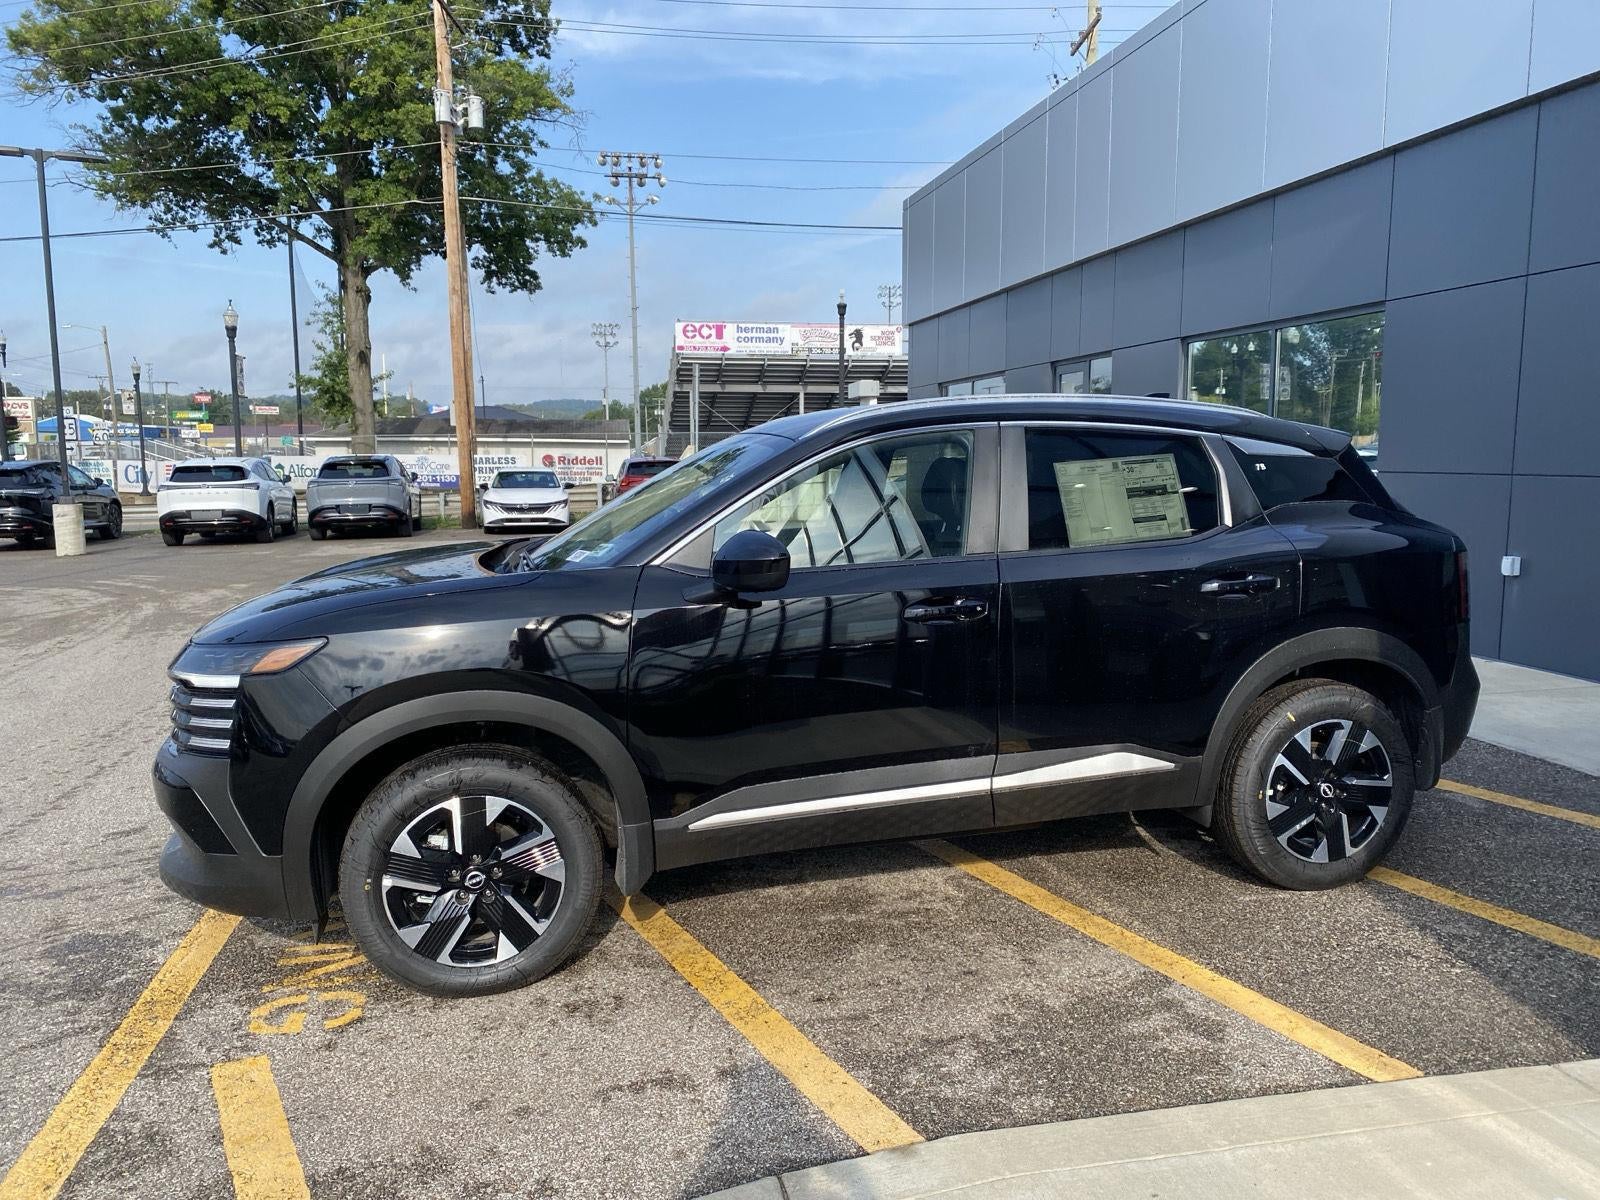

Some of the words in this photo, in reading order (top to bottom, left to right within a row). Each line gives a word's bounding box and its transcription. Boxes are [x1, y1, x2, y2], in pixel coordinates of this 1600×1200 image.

[736, 325, 779, 334] herman
[736, 335, 785, 346] cormany
[12, 402, 29, 410] CVS
[94, 432, 109, 441] 60
[557, 455, 603, 466] Riddell
[289, 463, 319, 478] Alfor
